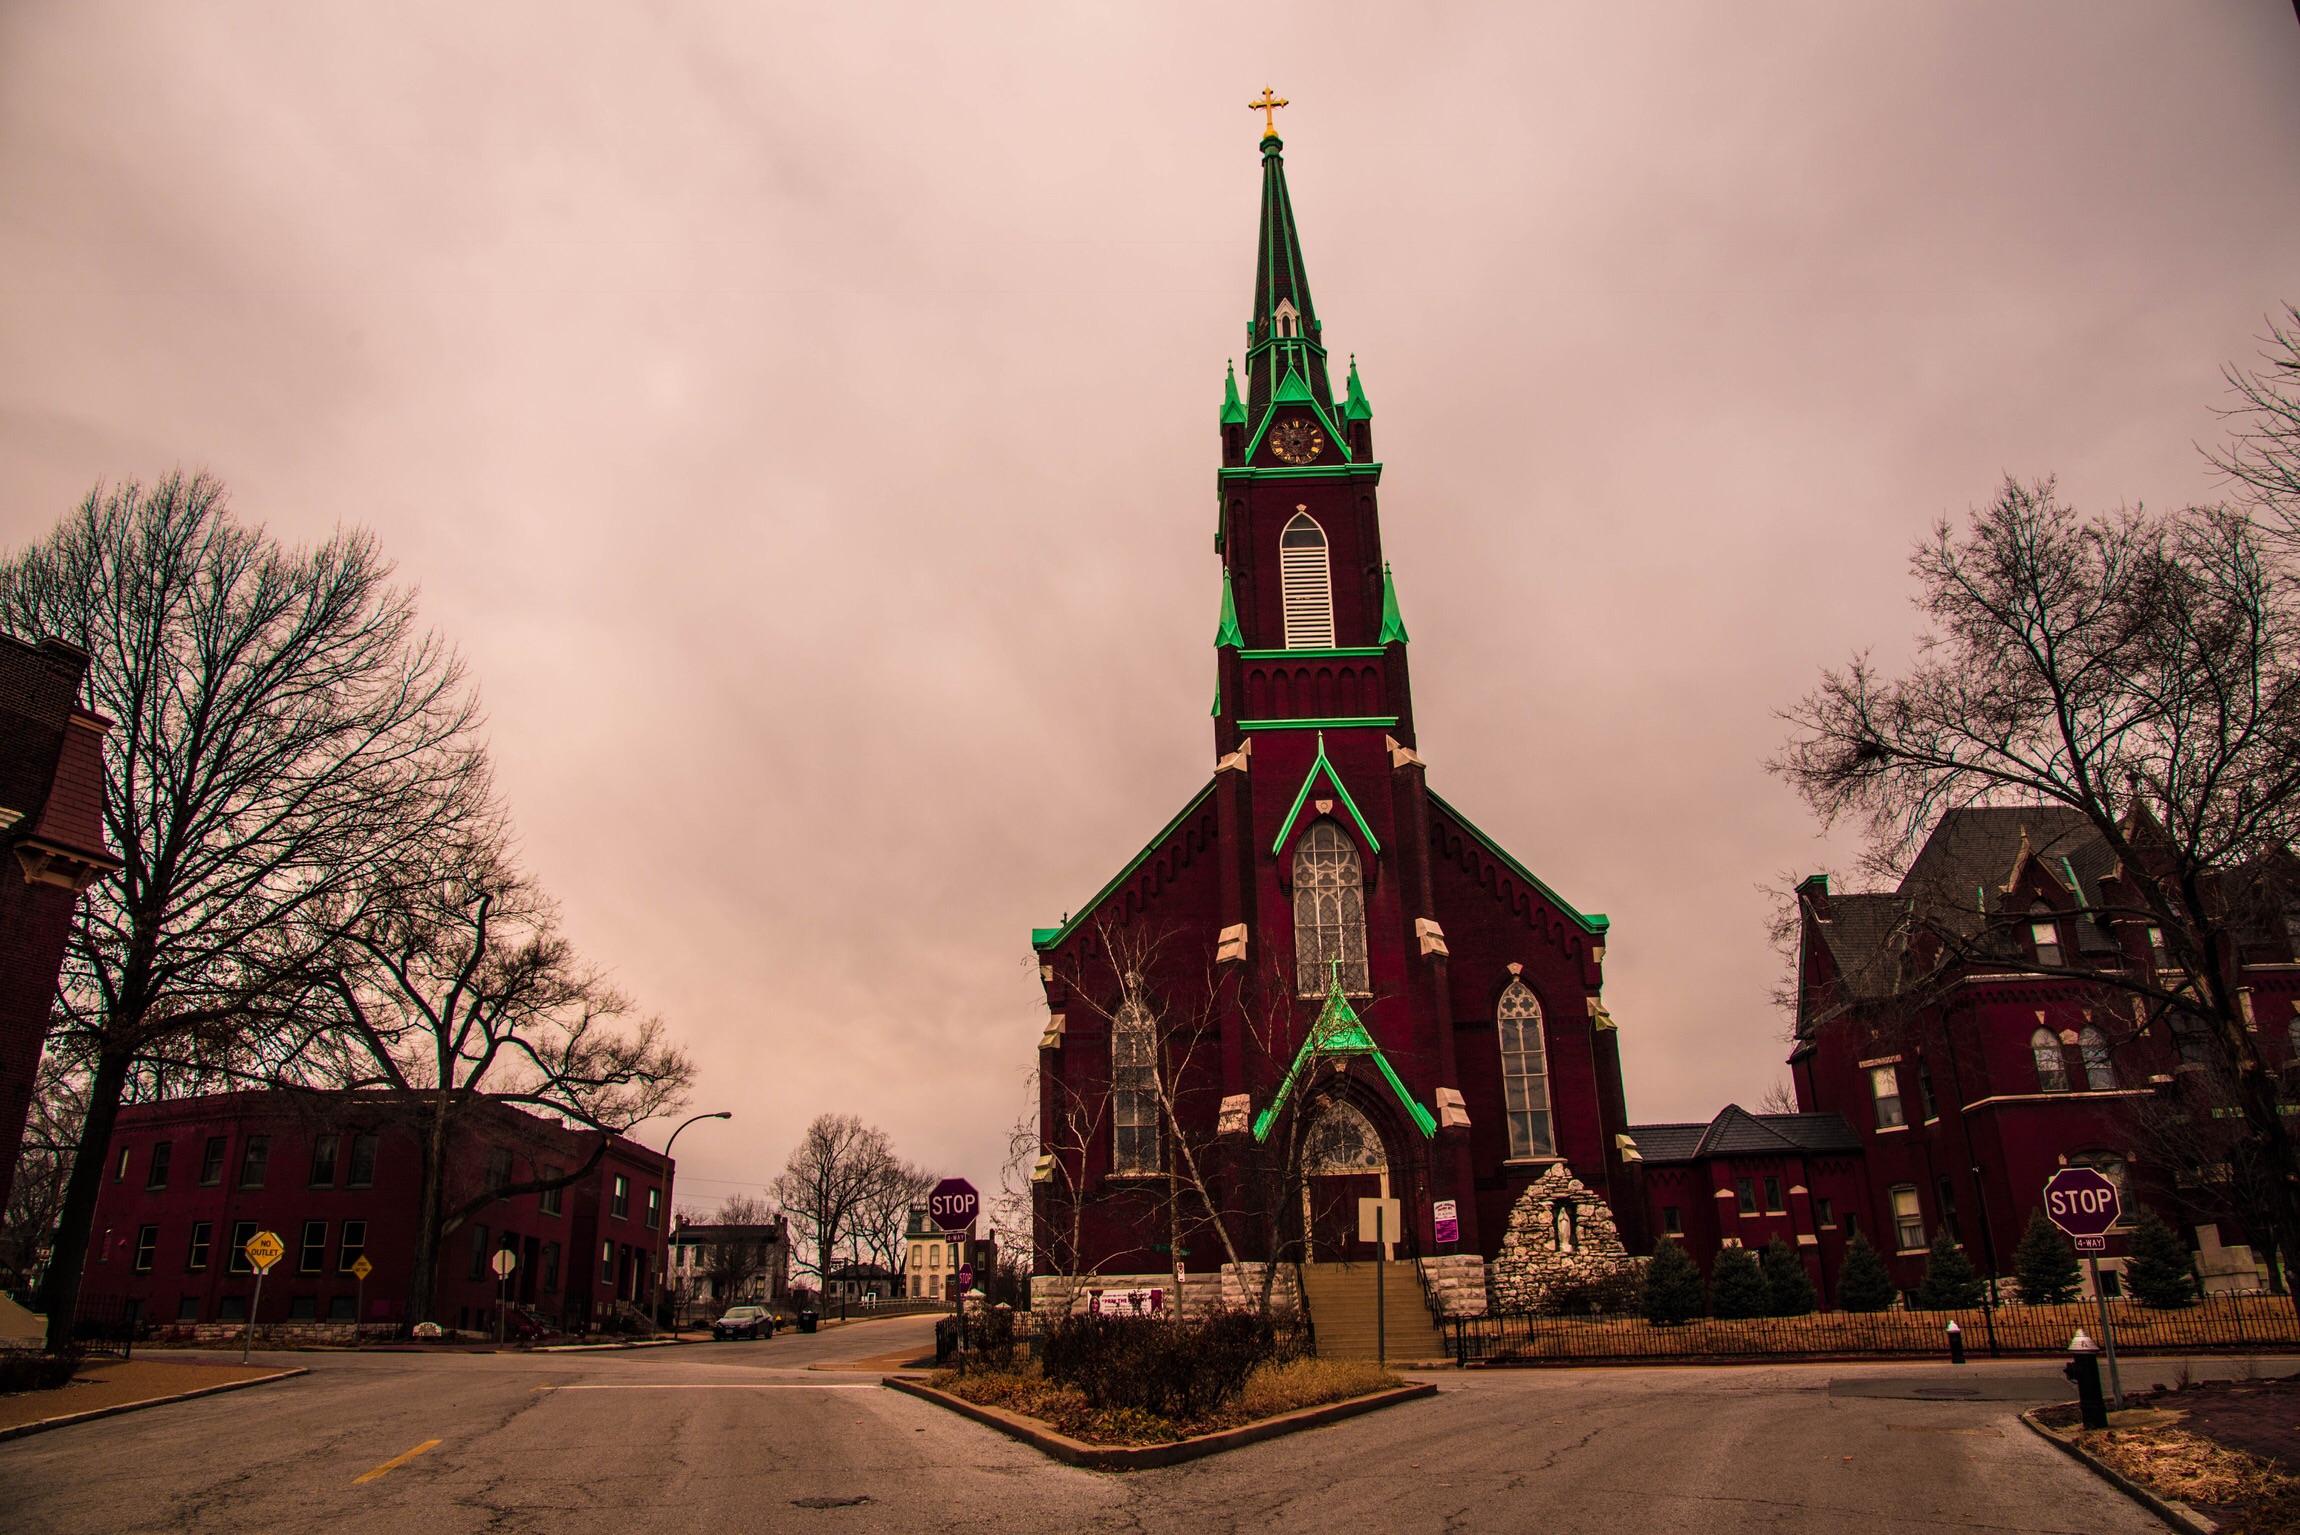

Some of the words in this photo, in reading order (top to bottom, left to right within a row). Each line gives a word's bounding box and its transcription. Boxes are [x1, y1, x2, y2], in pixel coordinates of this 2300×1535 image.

[932, 1193, 976, 1215] STOP
[2050, 1188, 2112, 1215] STOP
[946, 1233, 964, 1241] 4-WAY
[260, 1240, 272, 1248] NO
[2077, 1238, 2102, 1248] 4-WAY
[251, 1248, 279, 1257] OUTLET
[959, 1272, 972, 1284] STOP
